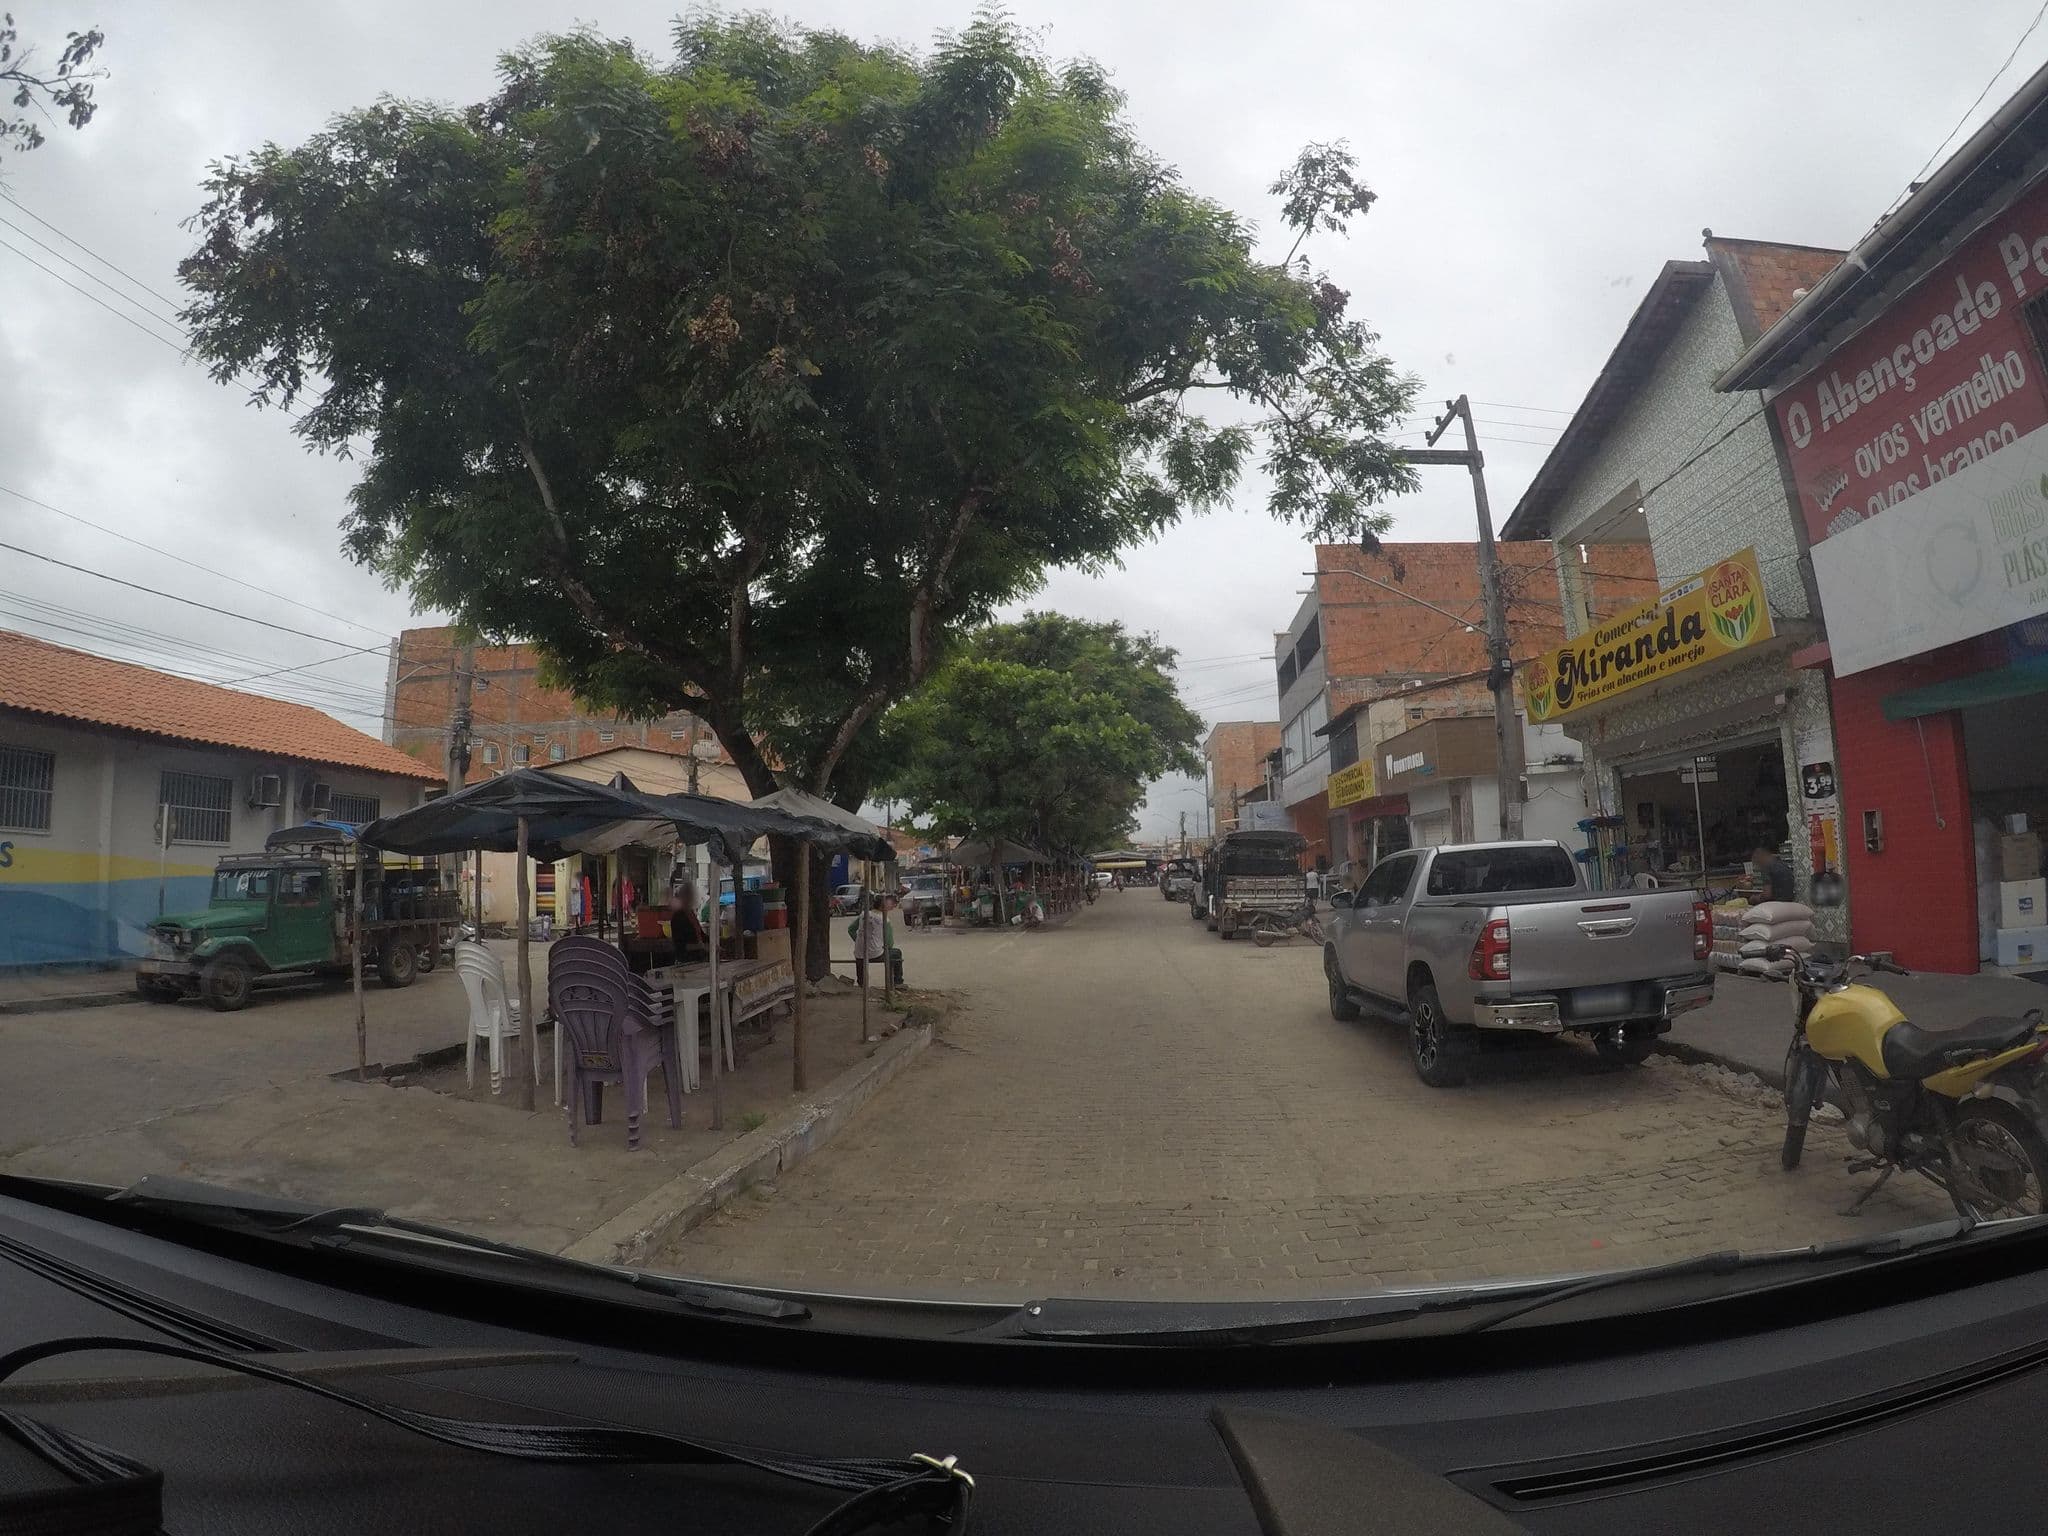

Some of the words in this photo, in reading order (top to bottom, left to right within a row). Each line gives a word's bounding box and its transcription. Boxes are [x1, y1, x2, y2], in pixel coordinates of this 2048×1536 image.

[1787, 400, 1812, 449] O
[1816, 273, 2002, 432] Abençoado
[1854, 421, 1911, 479] ovos
[1909, 350, 2026, 445] vermelho
[1711, 569, 1744, 593] SANTA
[1711, 581, 1750, 609] CLARA
[1594, 602, 1660, 648] Comercial
[1555, 605, 1706, 710] Miranda
[1602, 680, 1616, 693] em
[1617, 664, 1656, 688] atacado
[1668, 645, 1706, 667] varejo
